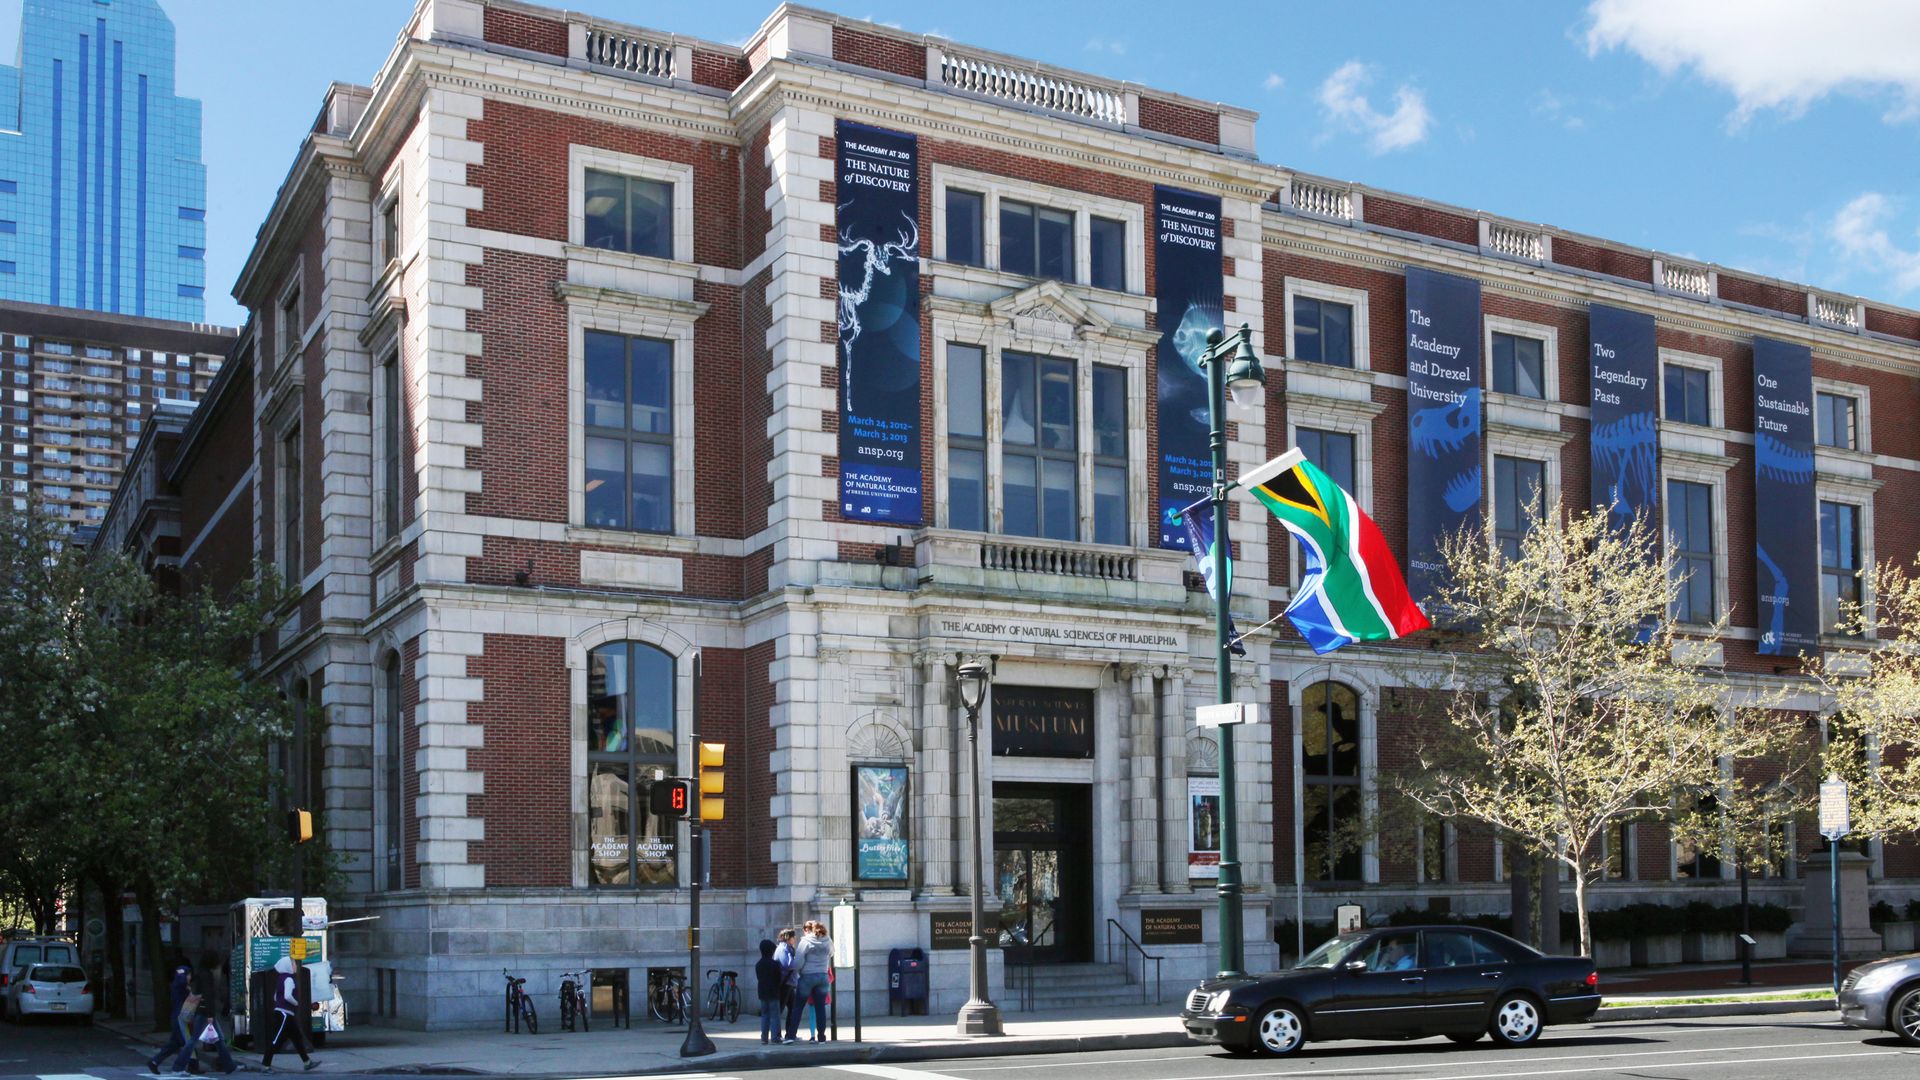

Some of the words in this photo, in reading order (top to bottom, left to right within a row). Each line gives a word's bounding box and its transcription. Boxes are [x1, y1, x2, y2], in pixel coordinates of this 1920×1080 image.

[845, 141, 857, 150] THE
[858, 143, 888, 155] ACADEMY
[898, 151, 910, 160] 200
[845, 158, 867, 171] THE
[868, 162, 910, 179] NATURE
[844, 173, 855, 183] of
[855, 174, 911, 193] DISCOVERY
[1161, 203, 1171, 211] THE
[1172, 206, 1197, 217] ACADEMY
[1161, 219, 1179, 231] THE
[1181, 223, 1215, 238] NATURE
[1160, 232, 1169, 243] of
[1169, 233, 1216, 250] DISCOVERY
[1410, 309, 1431, 327] The
[1410, 334, 1460, 359] Academy
[1594, 343, 1615, 359] Two
[1410, 360, 1428, 375] and
[1431, 363, 1471, 381] Drexel
[1594, 366, 1648, 390] Legendary
[1757, 374, 1778, 389] One
[1410, 381, 1468, 408] University
[1594, 388, 1620, 405] Pasts
[1758, 395, 1810, 416] Sustainable
[848, 415, 875, 426] March
[876, 420, 888, 429] 24,
[1758, 416, 1788, 433] Future
[853, 428, 880, 439] March
[881, 433, 889, 441] 3,
[890, 434, 908, 444] 2013
[858, 446, 904, 461] ansp.org
[1165, 454, 1187, 464] March
[845, 472, 858, 480] THE
[859, 473, 892, 483] ACADEMY
[1170, 466, 1191, 475] March
[856, 481, 886, 491] NATURAL
[887, 485, 918, 494] SCIENCES
[870, 491, 900, 499] UNIVERSITY
[1173, 482, 1212, 495] ansp.org
[1761, 594, 1790, 607] ansp.org
[941, 620, 961, 632] THE
[963, 622, 1006, 634] ACADEMY
[1009, 625, 1021, 636] OF
[1022, 627, 1060, 639] NATURAL
[1064, 629, 1104, 641] SCIENCES
[1106, 632, 1117, 642] OF
[1120, 634, 1177, 646] PHILADELPHIA
[637, 843, 674, 851] ACADEMY
